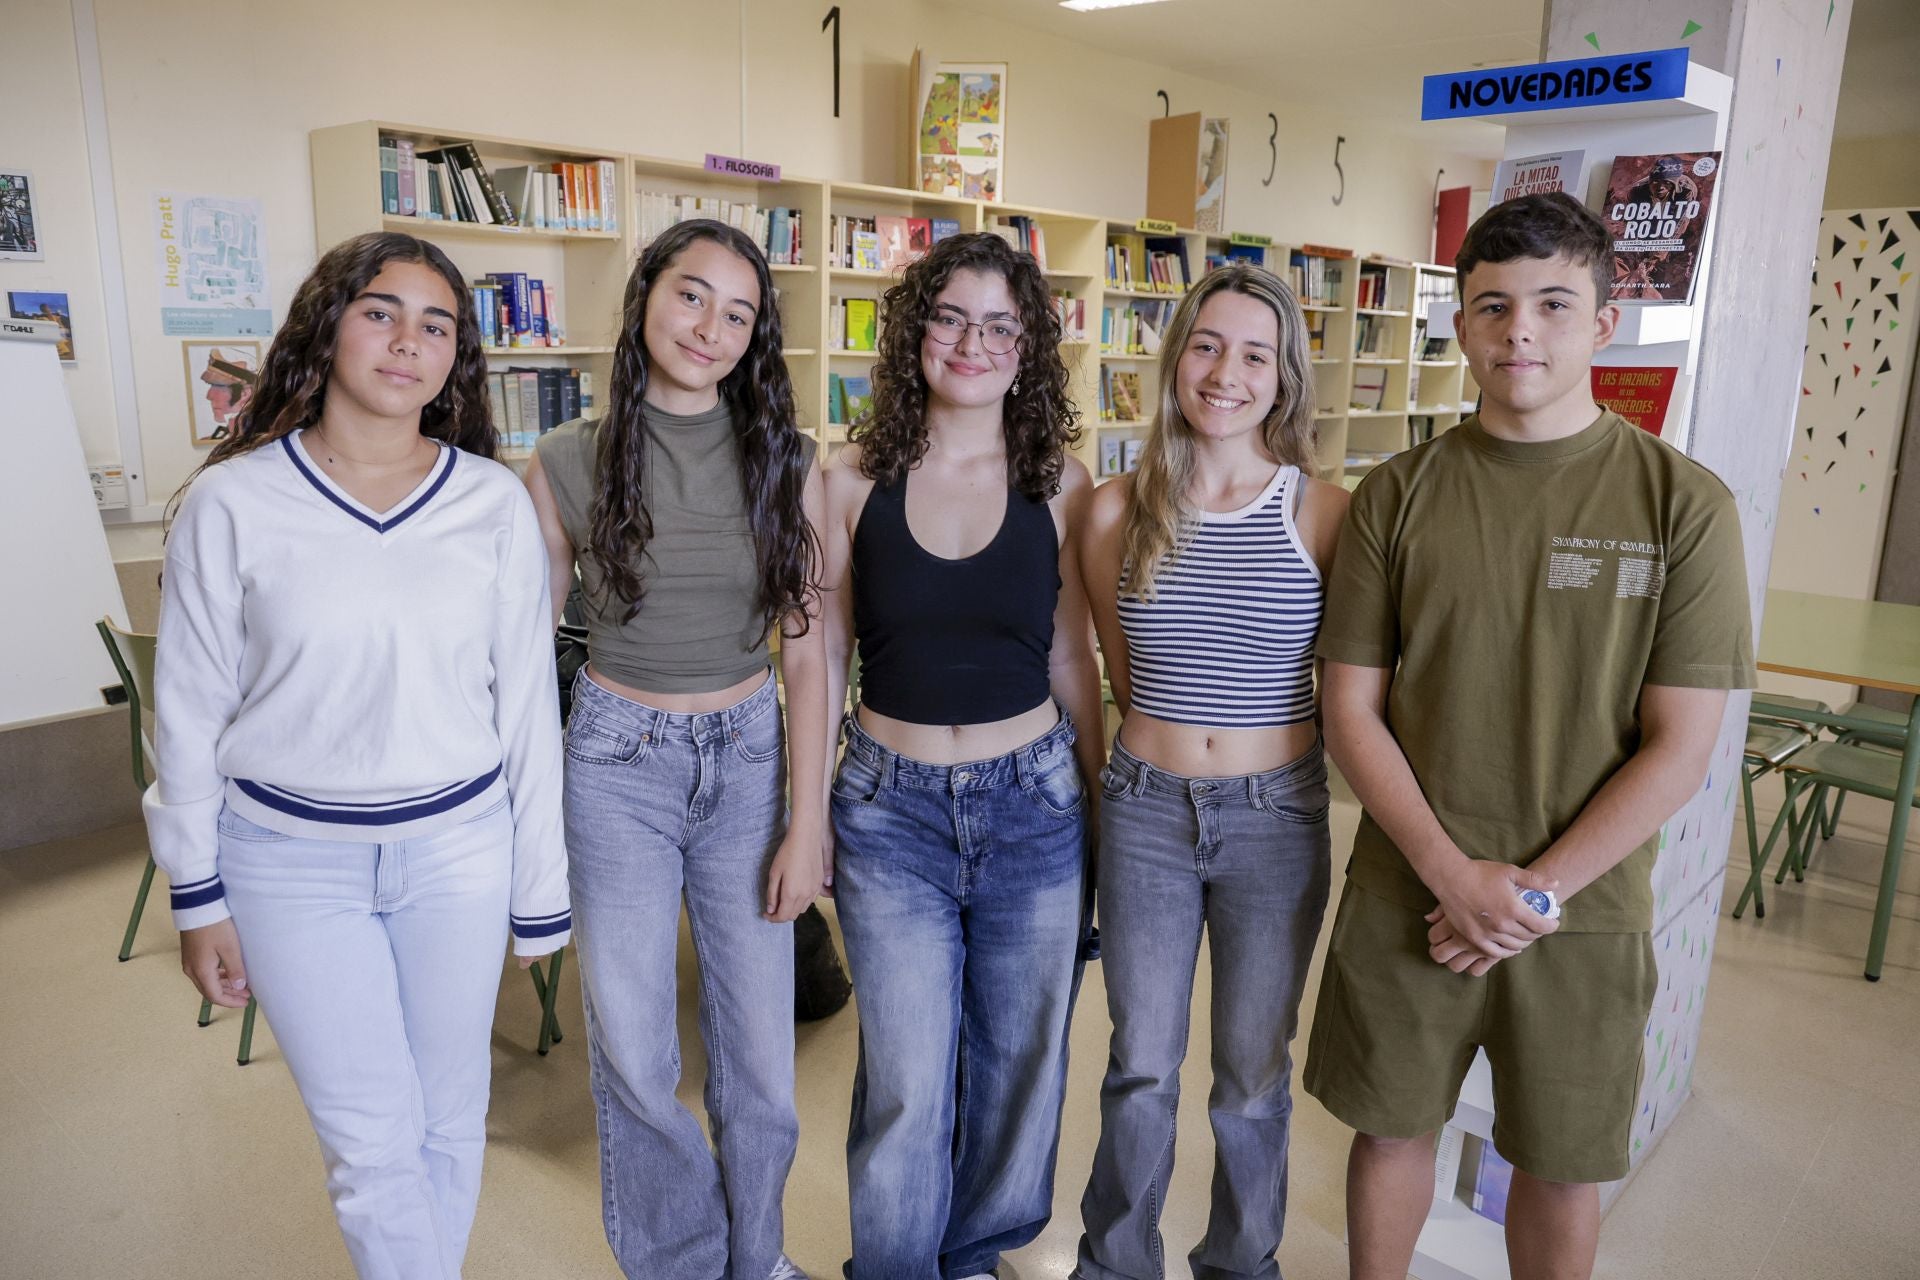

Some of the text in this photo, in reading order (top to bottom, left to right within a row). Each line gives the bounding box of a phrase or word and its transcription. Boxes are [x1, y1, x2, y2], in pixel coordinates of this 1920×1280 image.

[822, 6, 840, 118] 1
[1450, 61, 1652, 110] NOVEDADES
[1262, 113, 1278, 186] 3
[712, 158, 774, 178] 1. FILOSOFÍA
[1332, 136, 1345, 206] 5
[1514, 165, 1560, 186] LA MITAD
[1611, 201, 1700, 220] COBALTO
[1623, 220, 1677, 239] ROJO
[159, 197, 181, 287] Hugo Pratt
[1600, 371, 1662, 386] LAS HAZAÑAS
[1551, 536, 1600, 549] SYMPHONY
[1603, 540, 1617, 550] OF
